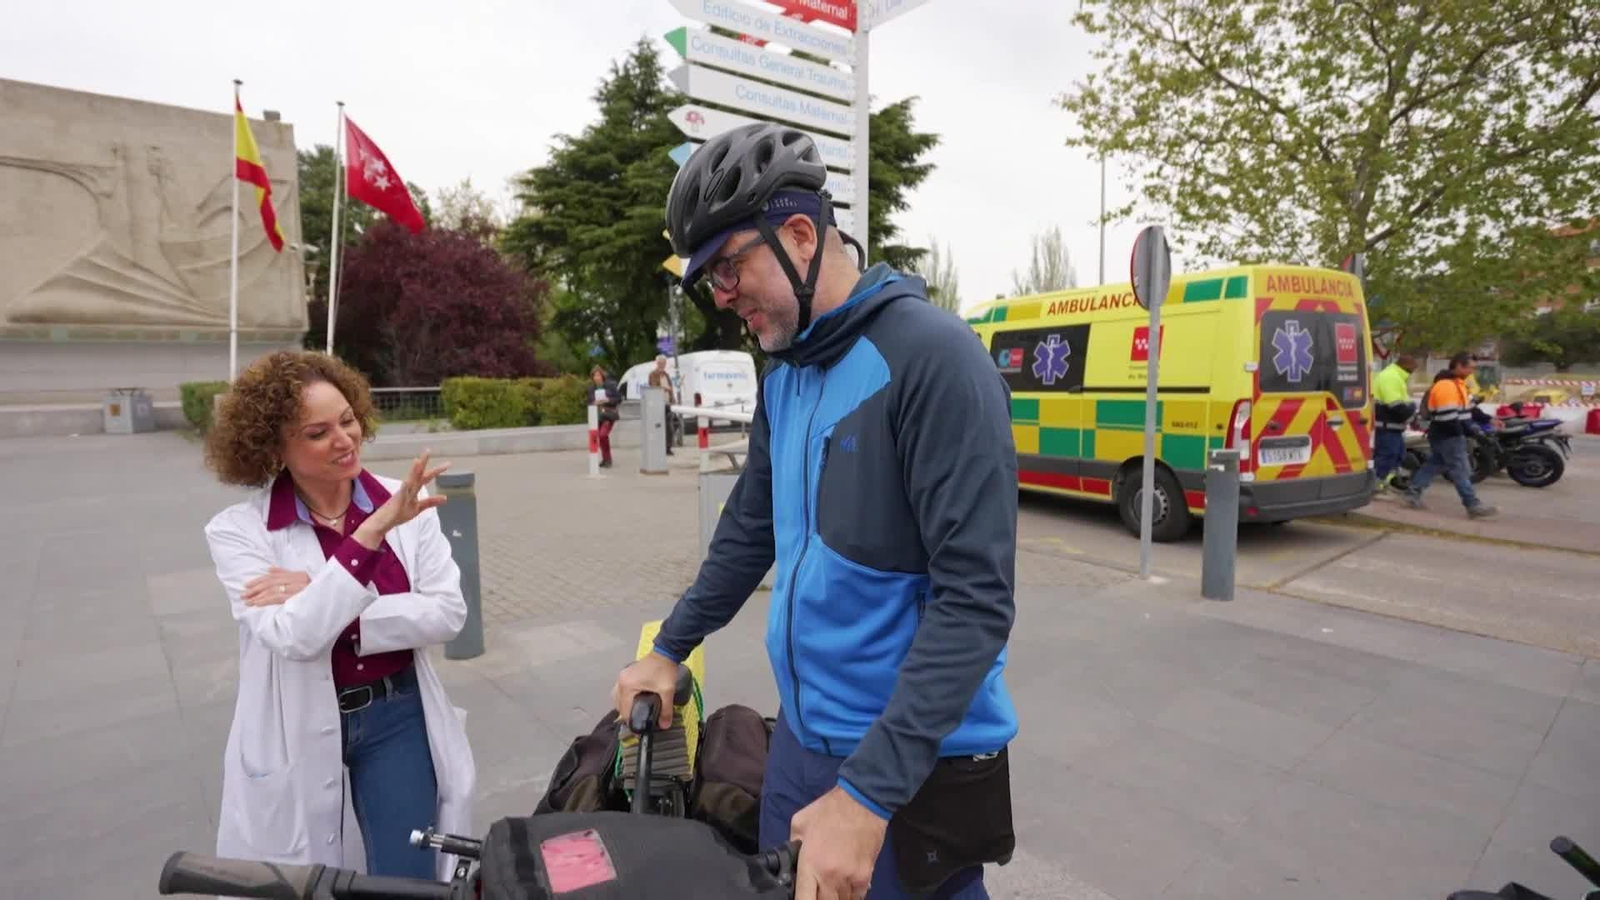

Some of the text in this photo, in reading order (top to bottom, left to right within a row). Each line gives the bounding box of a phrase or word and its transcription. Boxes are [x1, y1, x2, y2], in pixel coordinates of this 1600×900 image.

[754, 16, 770, 33] de
[691, 37, 756, 67] Consultas
[759, 49, 804, 79] General
[735, 83, 848, 125] Consultas Maternal
[1266, 274, 1354, 299] AMBULANCIA
[1047, 292, 1140, 315] AMBULANCI
